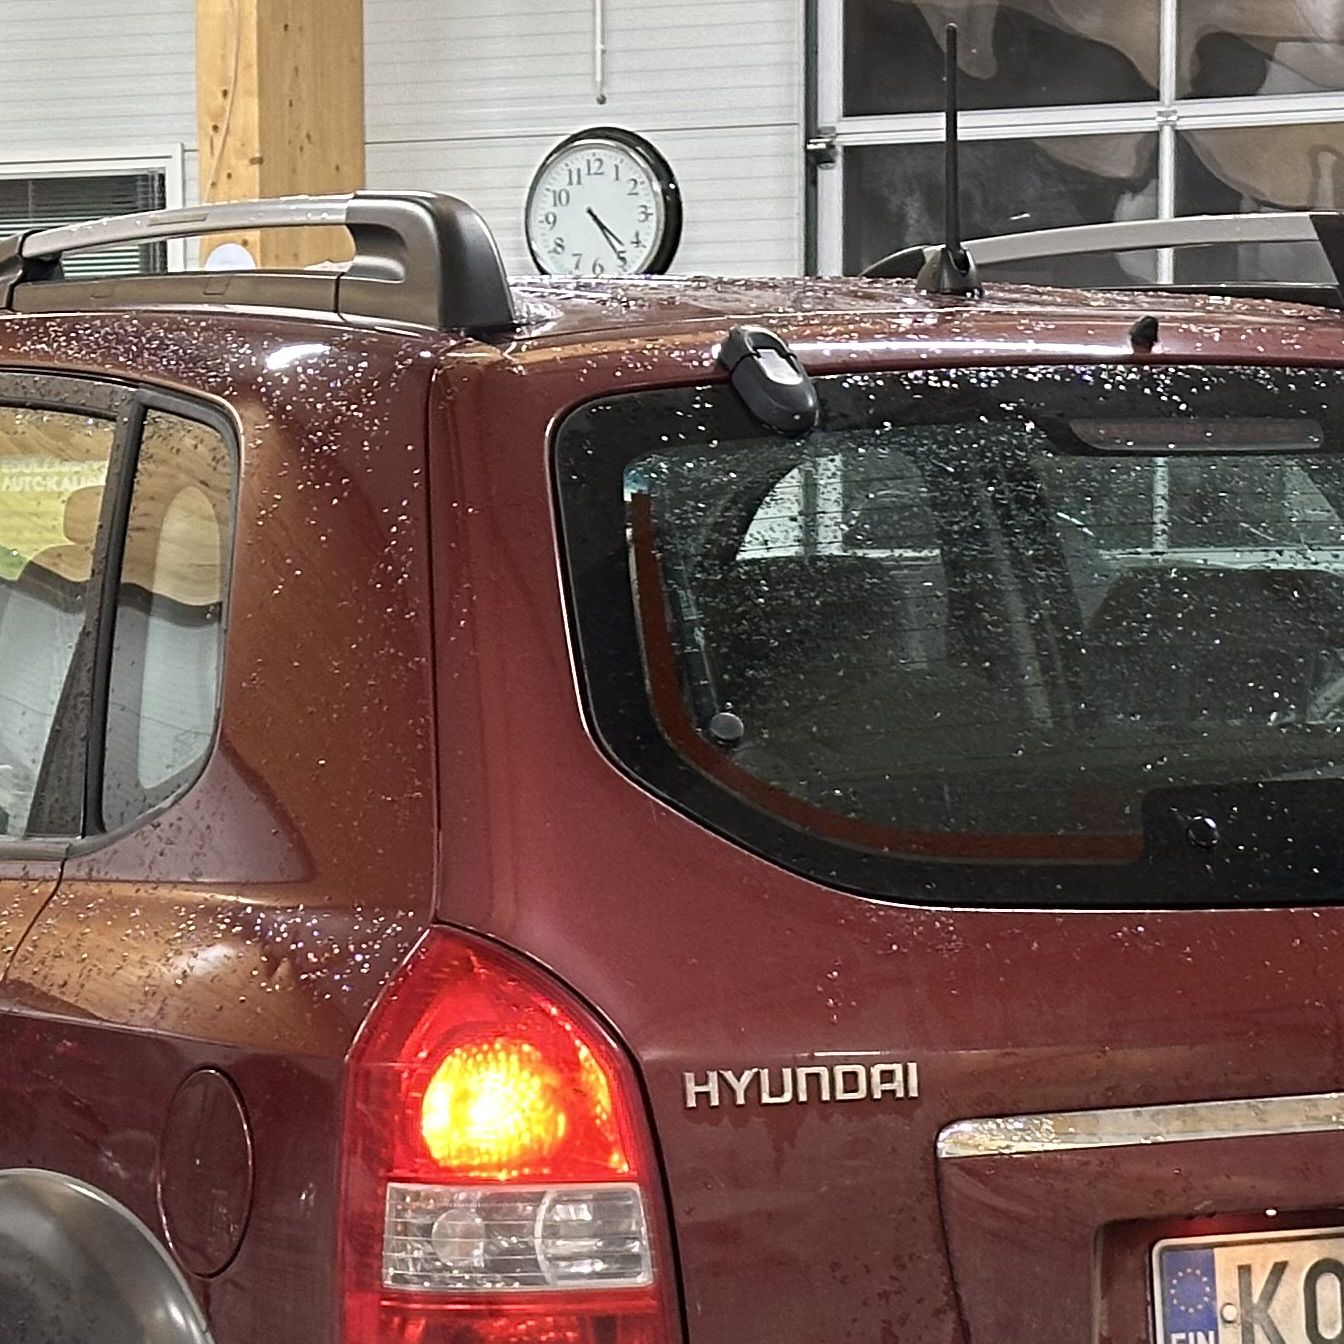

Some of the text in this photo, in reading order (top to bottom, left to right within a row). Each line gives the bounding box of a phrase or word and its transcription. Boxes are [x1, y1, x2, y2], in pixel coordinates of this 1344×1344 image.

[586, 158, 605, 176] 12
[613, 164, 621, 182] 1
[567, 168, 583, 186] 11
[627, 178, 639, 196] 2
[552, 189, 570, 207] 10
[545, 211, 557, 231] 9
[638, 204, 649, 223] 3
[554, 237, 566, 255] 8
[631, 231, 642, 248] 4
[572, 253, 583, 270] 7
[592, 257, 605, 275] 6
[683, 1062, 919, 1108] HYUNDAI
